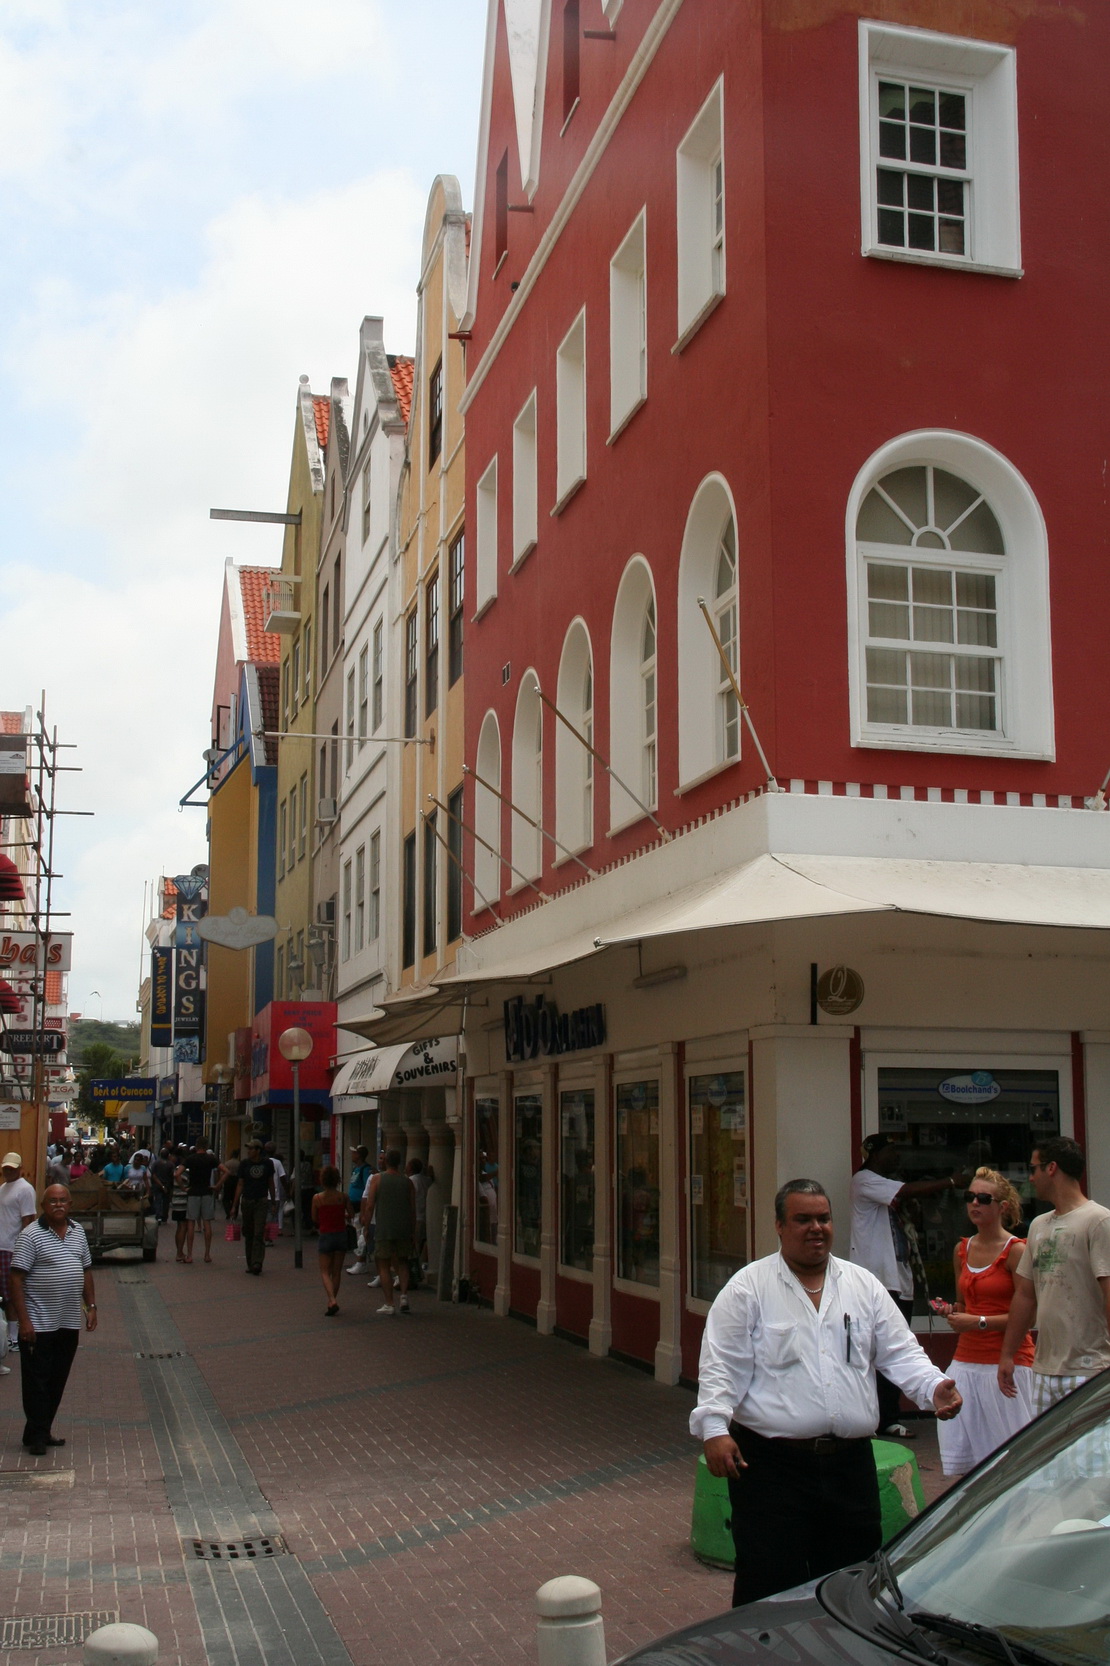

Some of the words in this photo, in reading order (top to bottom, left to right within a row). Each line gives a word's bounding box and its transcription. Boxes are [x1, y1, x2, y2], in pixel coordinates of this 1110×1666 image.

[178, 904, 199, 1015] KINGS
[412, 1038, 440, 1056] GIFTS
[423, 1052, 434, 1064] &
[395, 1060, 457, 1085] SOUVENIRS
[93, 1086, 109, 1097] Best
[110, 1086, 119, 1096] of
[120, 1086, 153, 1097] Curaçao
[950, 1084, 998, 1094] Boolchand's
